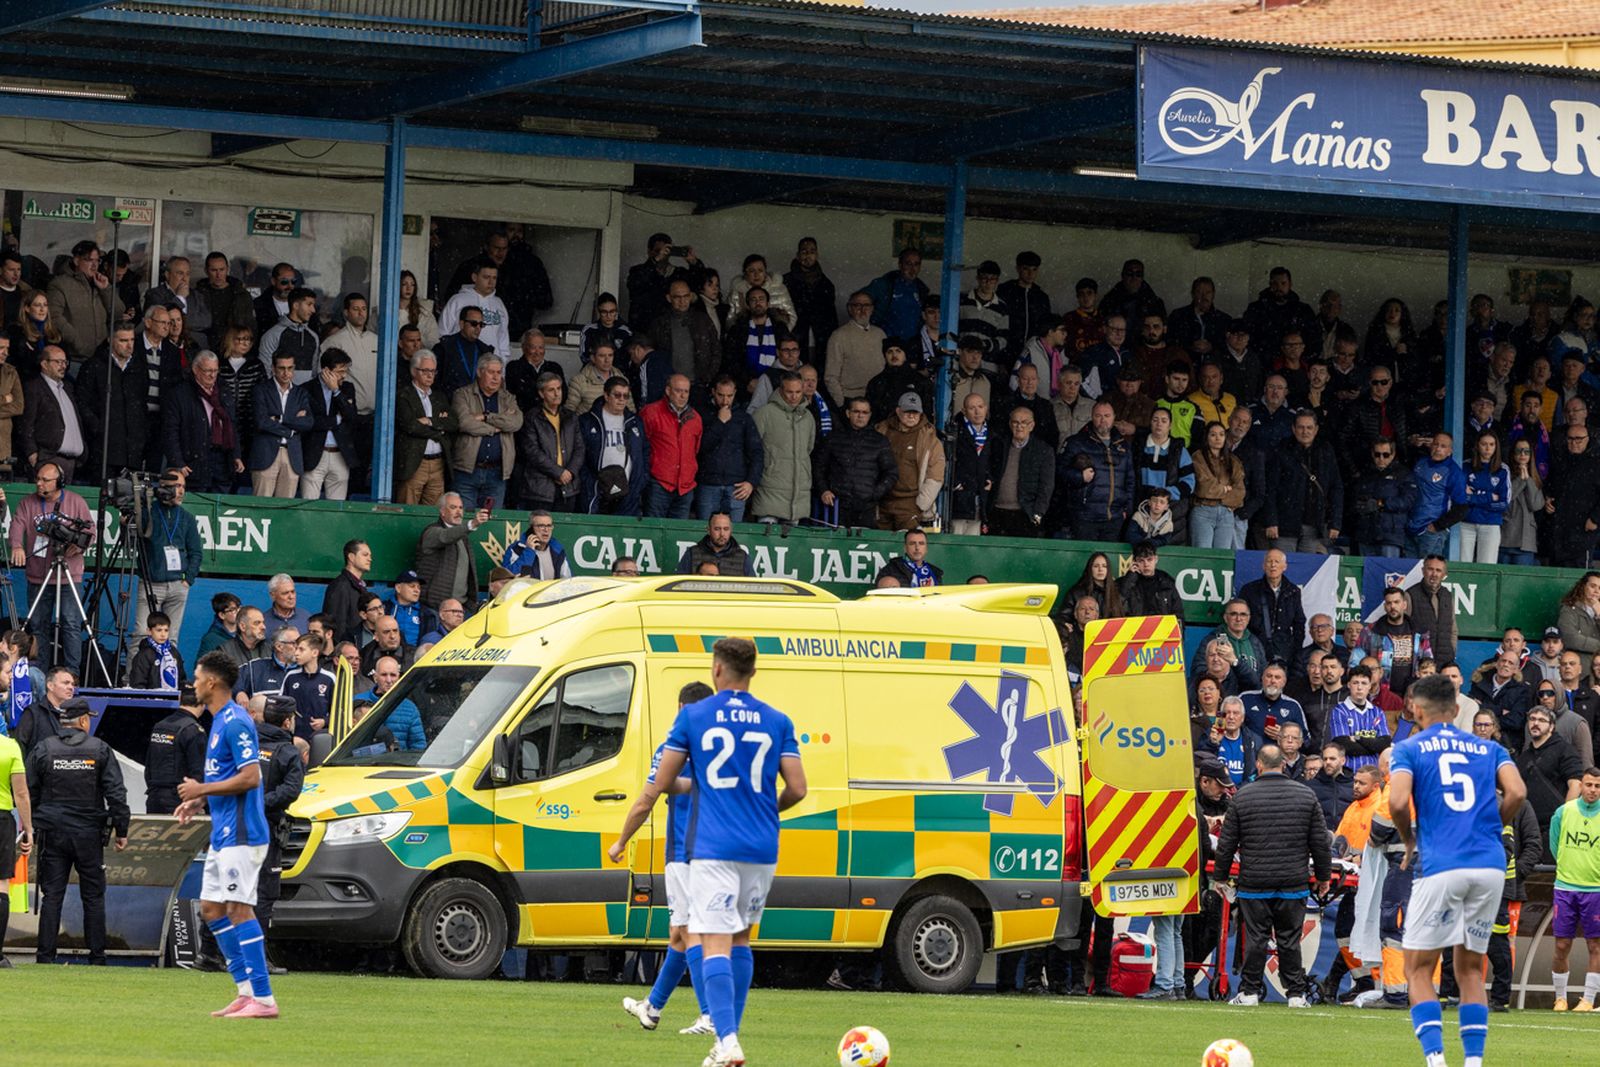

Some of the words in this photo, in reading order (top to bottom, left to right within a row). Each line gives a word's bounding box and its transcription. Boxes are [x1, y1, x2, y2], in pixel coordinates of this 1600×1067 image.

[1166, 109, 1213, 125] Aurelio
[1226, 68, 1391, 171] Mañas
[195, 509, 271, 552] AÉN
[573, 535, 661, 573] CAJA
[1175, 568, 1235, 605] CAJ
[784, 637, 899, 659] AMBULANCIA
[731, 709, 761, 724] COVA
[1117, 727, 1166, 758] ssg
[1418, 736, 1449, 753] JOÃO
[1451, 739, 1488, 755] PAULO
[701, 727, 773, 793] 27
[1438, 753, 1475, 812] 5
[546, 803, 570, 819] ssg
[1016, 847, 1059, 871] 112
[1117, 885, 1149, 899] 9756
[1153, 883, 1175, 897] MDX
[180, 920, 189, 946] TEAM
